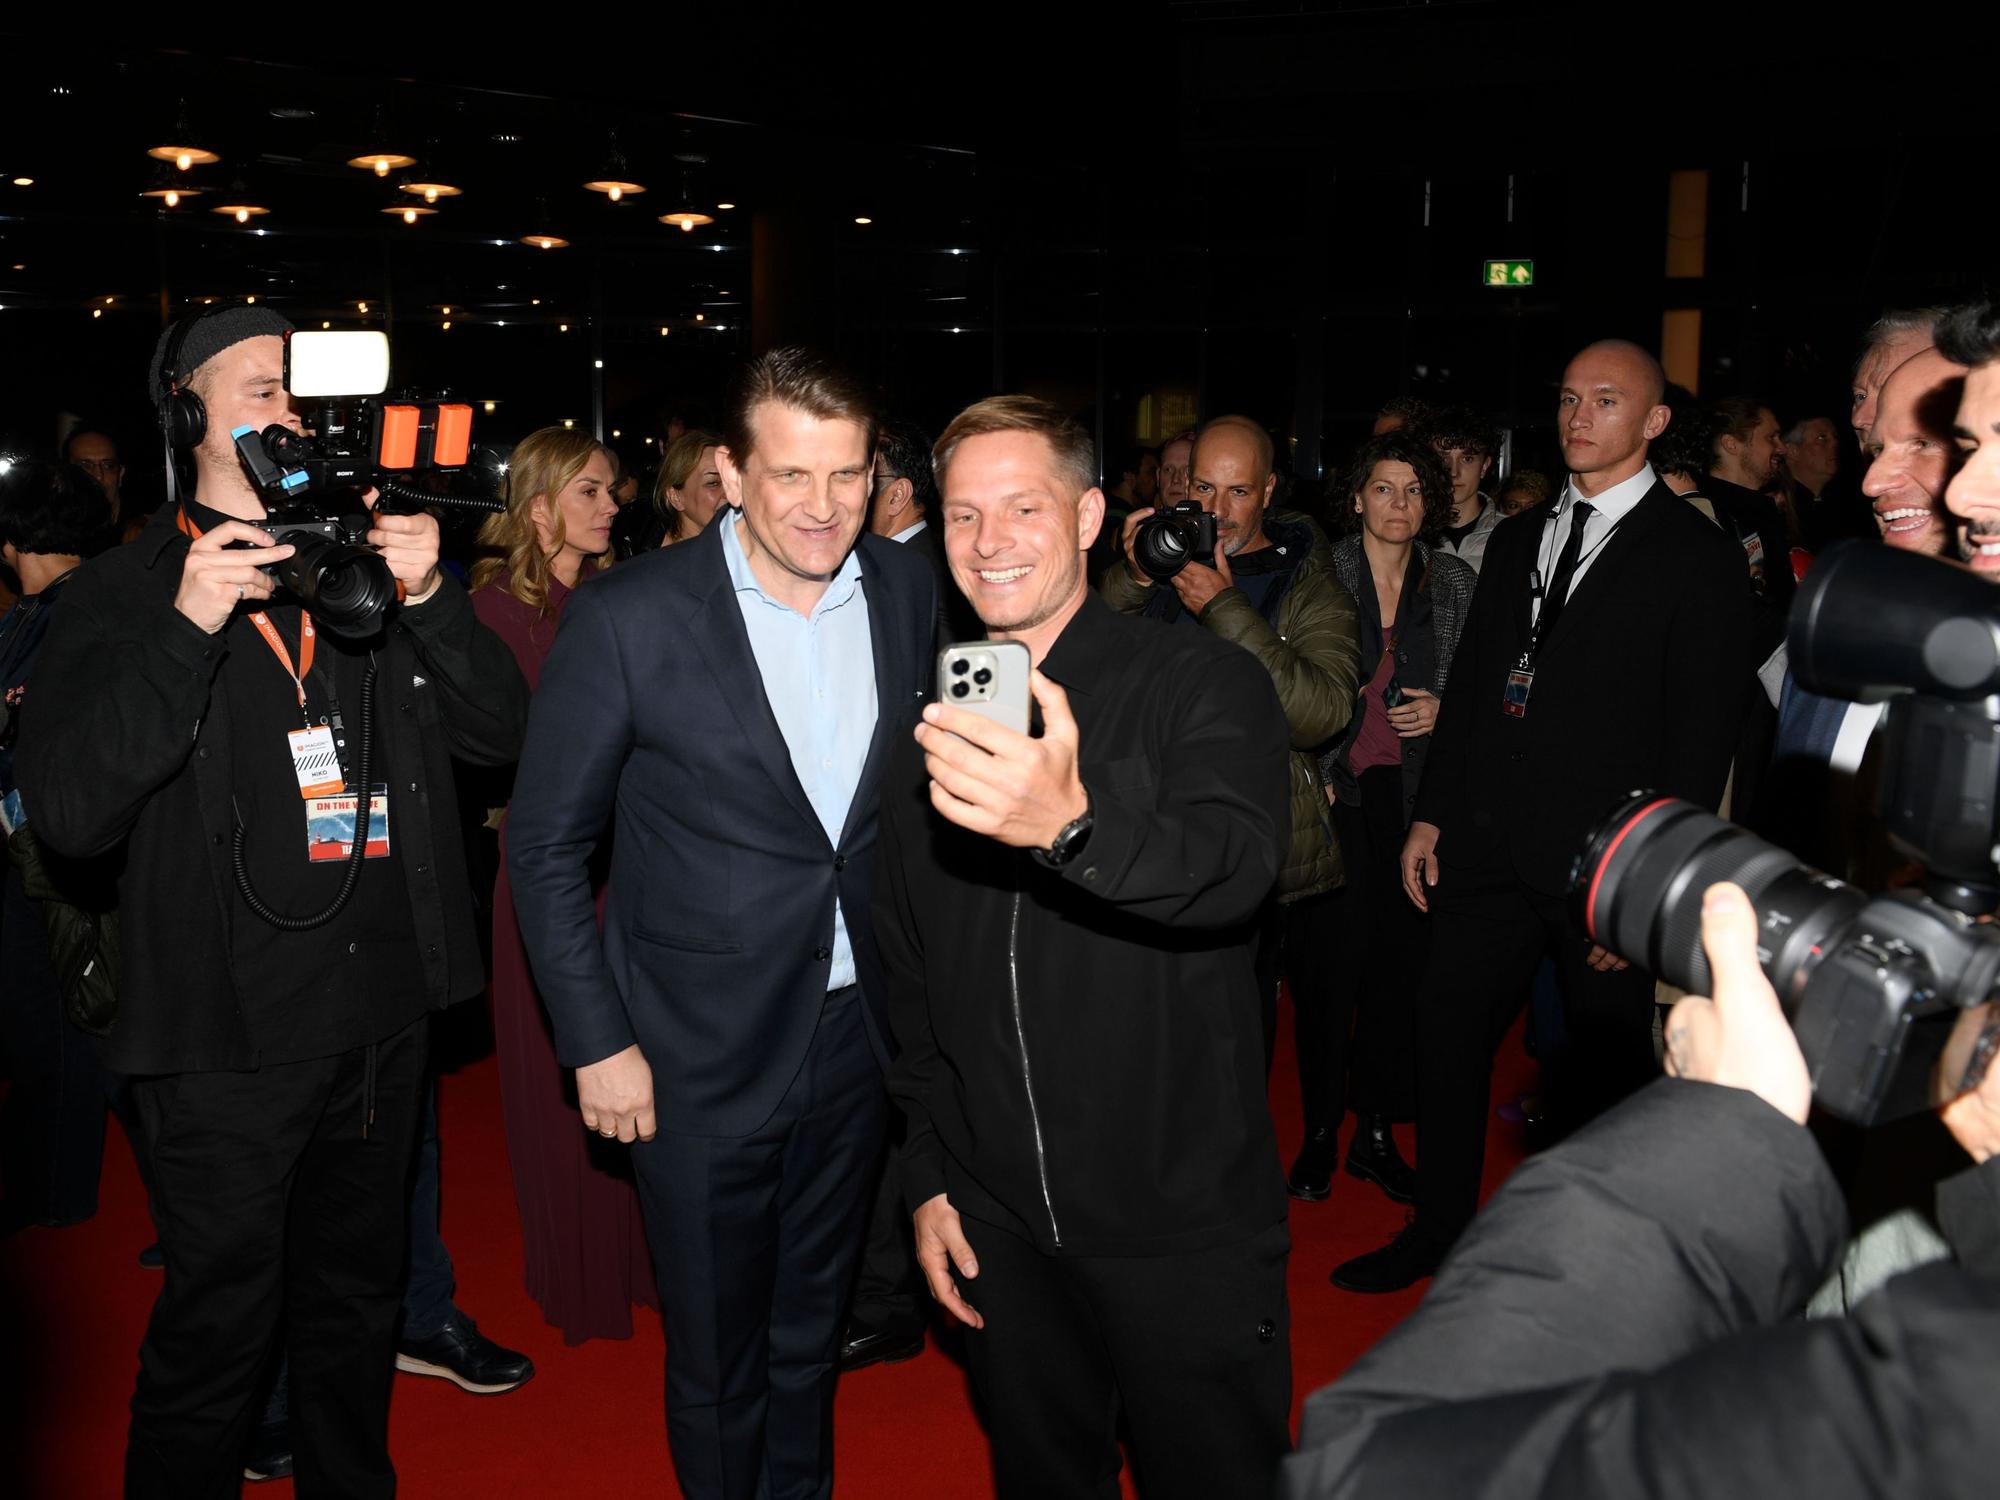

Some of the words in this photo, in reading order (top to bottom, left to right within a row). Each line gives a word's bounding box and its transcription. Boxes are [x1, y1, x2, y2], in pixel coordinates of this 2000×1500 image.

[316, 802, 331, 811] ON
[332, 801, 350, 810] THE
[352, 800, 378, 809] WVE
